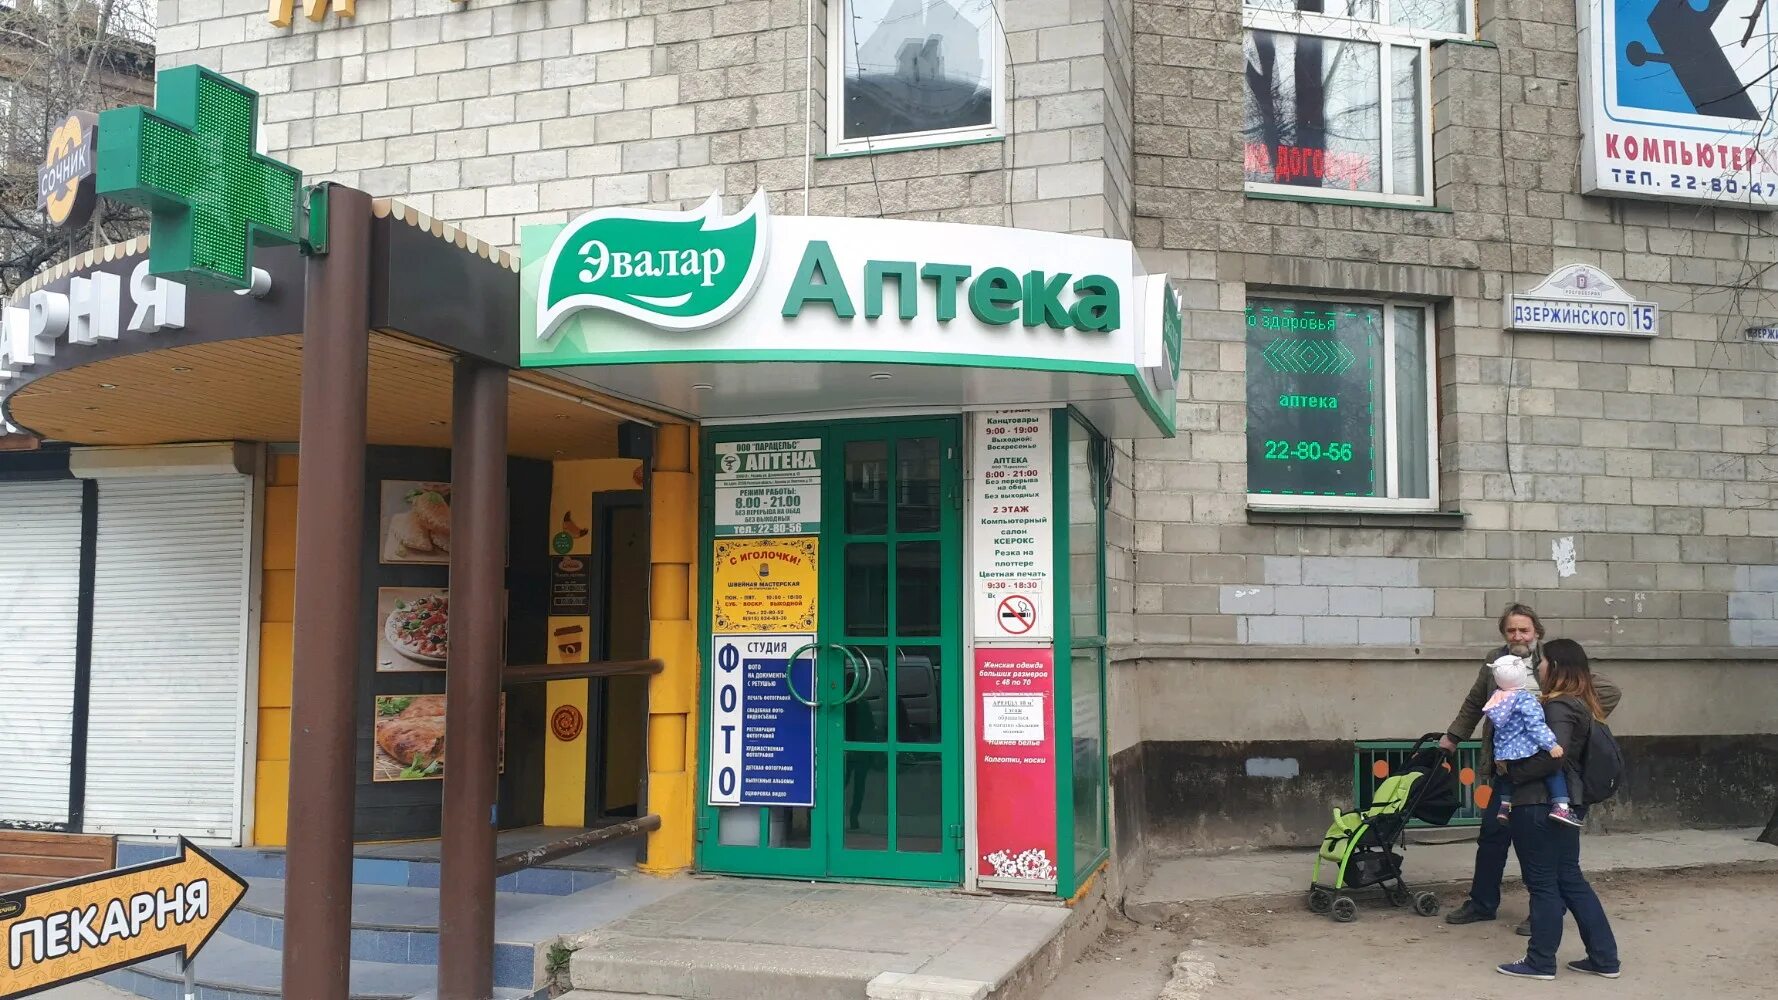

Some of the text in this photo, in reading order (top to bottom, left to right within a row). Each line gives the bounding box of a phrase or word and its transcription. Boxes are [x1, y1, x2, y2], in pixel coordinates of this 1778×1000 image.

[41, 143, 87, 197] СОЧНИК
[1670, 174, 1776, 198] 22-80-47
[577, 239, 726, 287] Эвалар
[781, 240, 1121, 333] Аптека
[1261, 314, 1338, 333] здоровья
[1514, 305, 1653, 331] ДЗЕРЖИНСКОГО 15
[1279, 393, 1339, 410] аптека
[987, 417, 1039, 425] Канцтовары
[985, 427, 1006, 435] 9:00
[1013, 426, 1039, 434] 19:00
[736, 440, 801, 452] ООО "ПАРАЦЕЛЬС"
[1264, 440, 1354, 462] 22-80-56
[745, 450, 817, 471] АПТЕКА
[985, 470, 1005, 478] 8:00
[1012, 469, 1038, 477] 21:00
[739, 487, 797, 497] РЕЖИМ РАБОТЫ:
[735, 497, 761, 509] 8.00
[769, 495, 801, 508] 21.00
[1001, 505, 1029, 513] ЭТАЖ
[981, 516, 1048, 525] Компьютерный
[757, 522, 802, 533] 22-80-56
[994, 537, 1034, 545] КСЕРОКС
[729, 551, 802, 566] С ИГОЛОЧКИ!
[987, 581, 1006, 589] 9:30
[1013, 581, 1038, 589] 18:30
[746, 641, 788, 654] СТУДИЯ
[983, 661, 1044, 669] Женская одежда
[718, 642, 740, 796] ФОТО
[984, 755, 1022, 765] Колготки,
[9, 878, 209, 969] ПЕКАРНЯ
